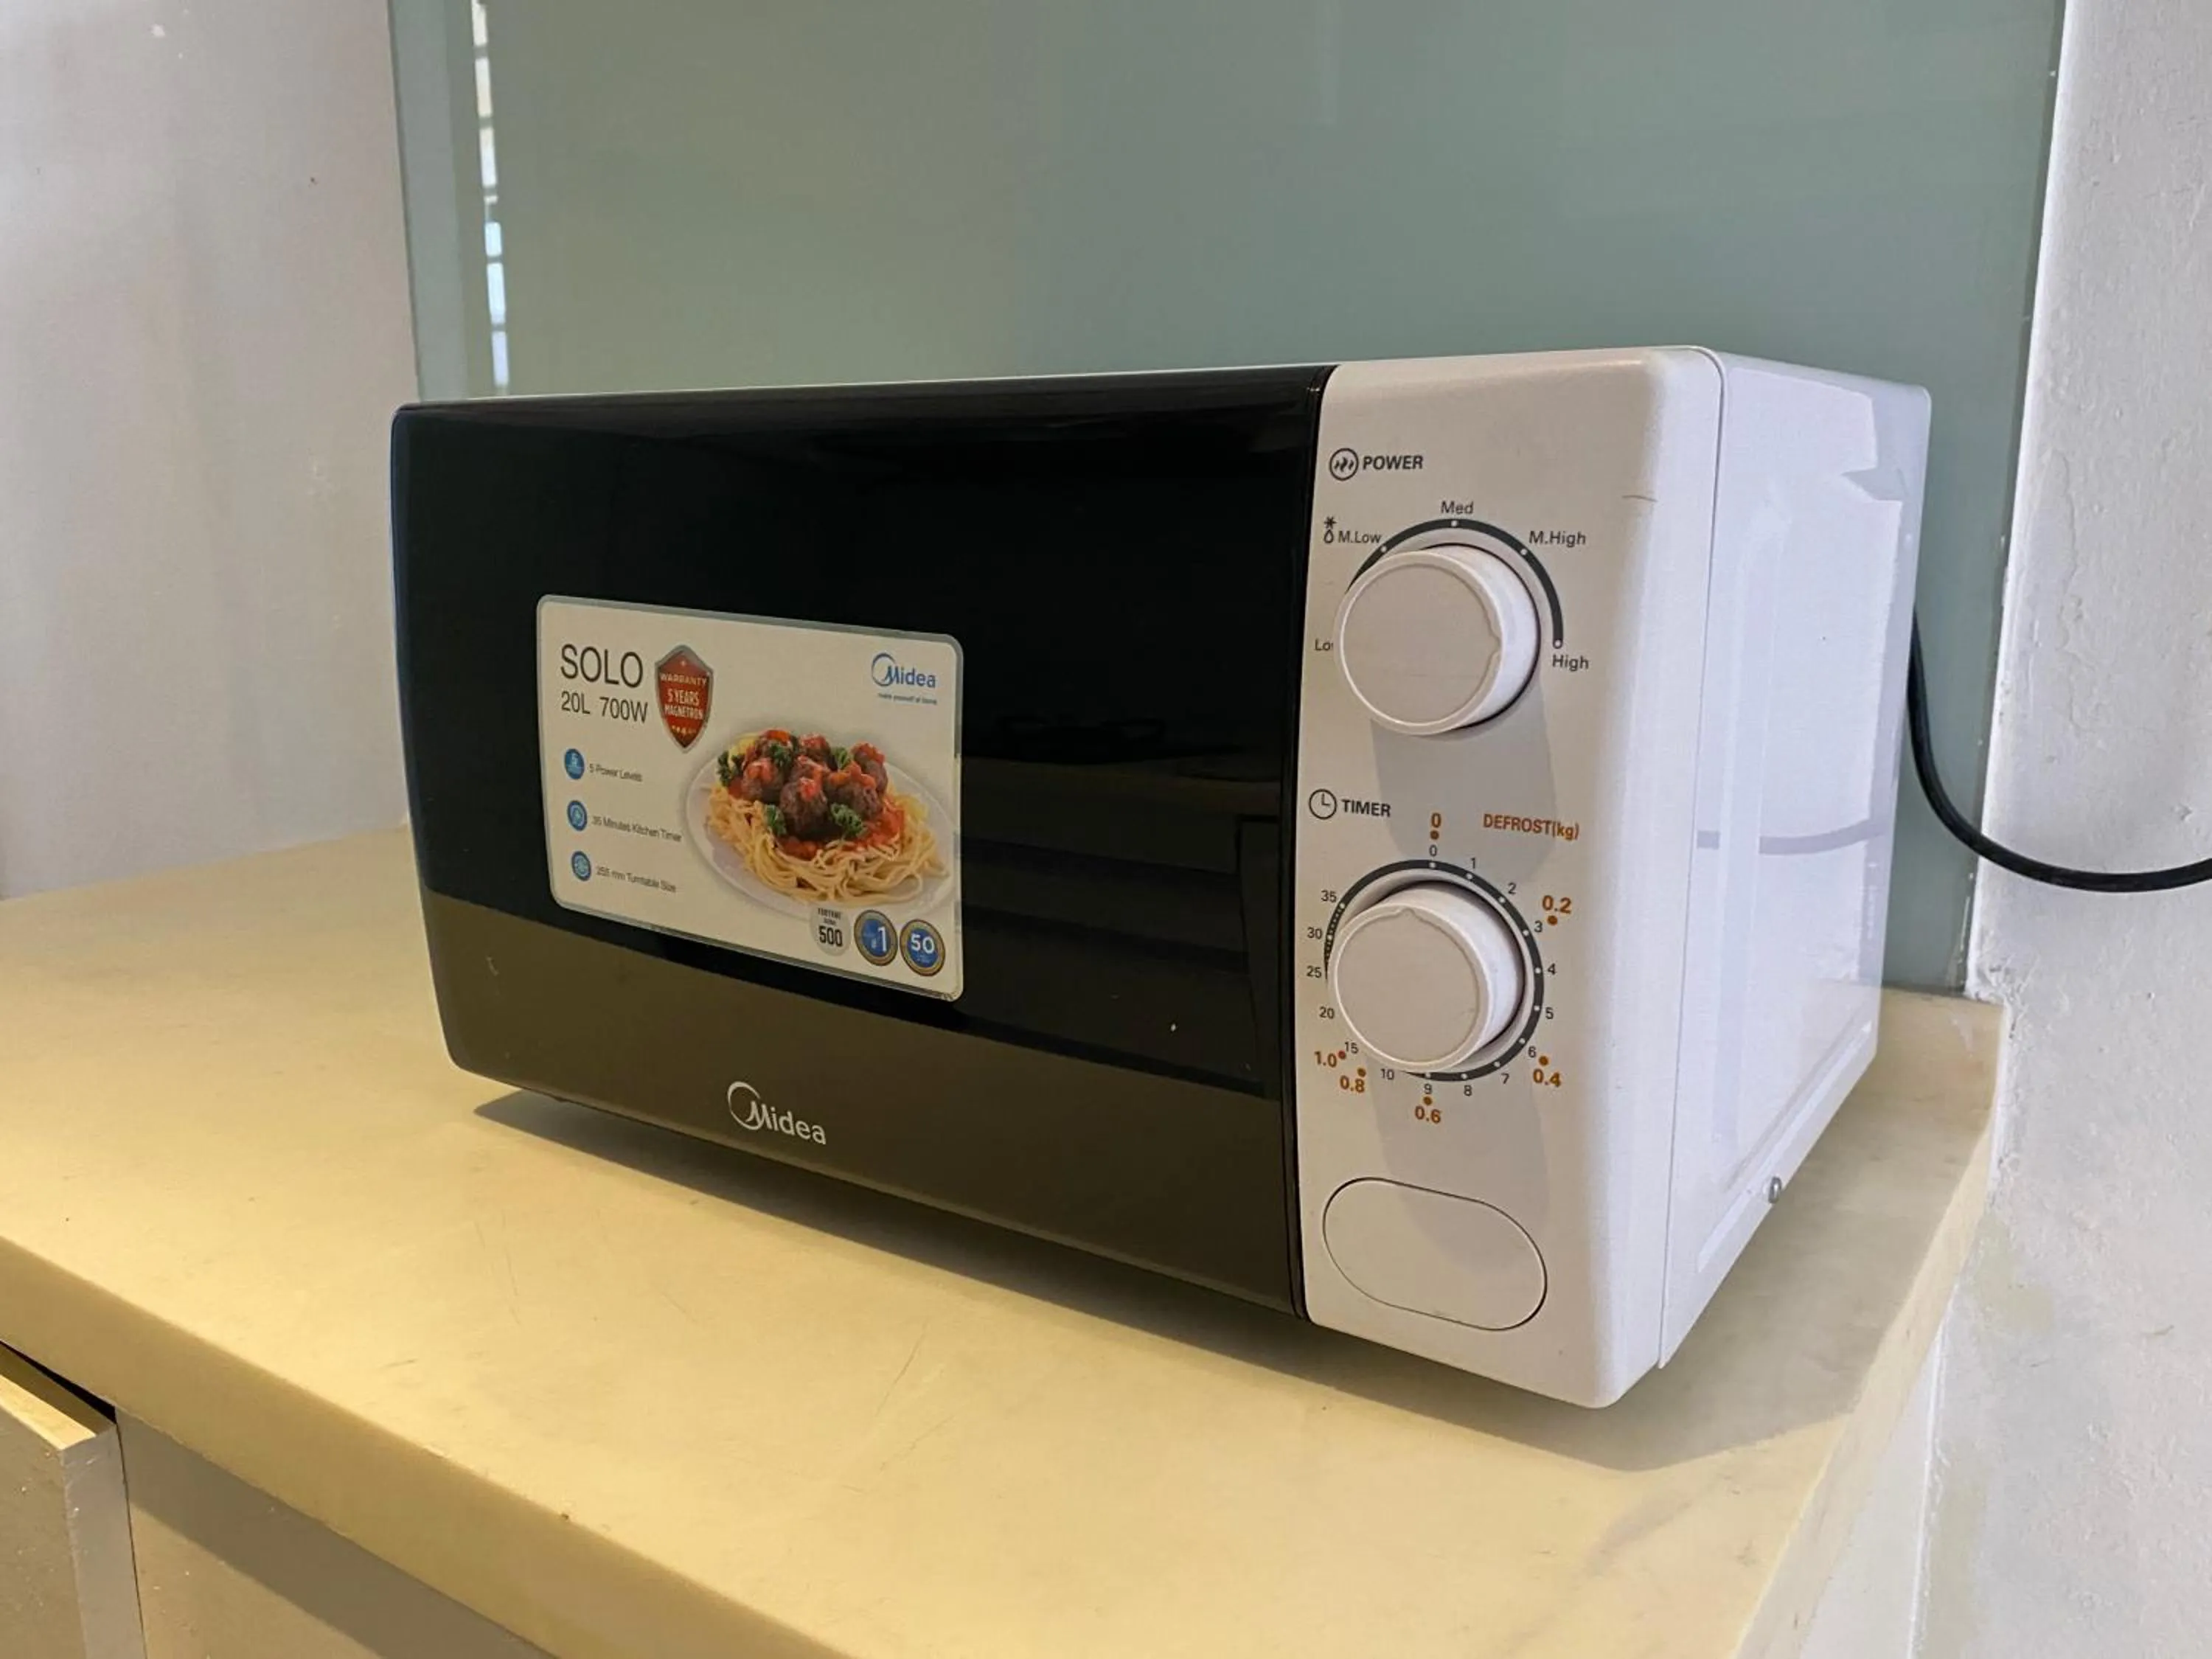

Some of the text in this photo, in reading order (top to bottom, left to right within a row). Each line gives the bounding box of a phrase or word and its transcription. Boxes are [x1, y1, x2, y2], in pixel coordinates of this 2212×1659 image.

[1363, 455, 1423, 470] POWER
[1441, 501, 1474, 515] Med
[1338, 531, 1382, 544] M.Low
[1528, 530, 1586, 546] M.High
[1315, 639, 1334, 651] Lo
[560, 643, 644, 688] SOLO
[872, 653, 936, 688] Midea
[1552, 655, 1589, 672] High
[660, 672, 707, 686] WARRANTY
[667, 688, 700, 706] 5 YEARS
[560, 690, 648, 723] 20L 700W
[664, 703, 704, 720] MAGNETRON
[589, 763, 643, 782] 5 Power Levels
[1341, 799, 1391, 818] TIMER
[1430, 813, 1441, 828] 0
[1483, 813, 1579, 841] DEFROST(kg)
[591, 815, 682, 842] 35 Minutes Kitchen Timer
[1428, 844, 1438, 857] 0
[1470, 858, 1476, 869] 1
[1508, 883, 1517, 894] 2
[1321, 890, 1337, 903] 35
[1542, 895, 1571, 914] 0.2
[1307, 927, 1323, 940] 30
[1534, 920, 1543, 933] 3
[818, 925, 843, 947] 500
[911, 933, 935, 954] 50
[1306, 966, 1322, 978] 25
[1547, 963, 1557, 975] 4
[1319, 1006, 1335, 1019] 20
[1545, 1007, 1554, 1020] 5
[1344, 1041, 1359, 1054] 15
[1528, 1046, 1537, 1058] 6
[1314, 1051, 1337, 1068] 1.0
[1380, 1068, 1394, 1080] 10
[1501, 1073, 1509, 1085] 7
[1532, 1068, 1562, 1088] 0.4
[1339, 1075, 1365, 1093] 0.8
[1424, 1083, 1433, 1094] 9
[1464, 1085, 1472, 1096] 8
[727, 1080, 826, 1144] Midea
[1414, 1106, 1442, 1124] 0.6
